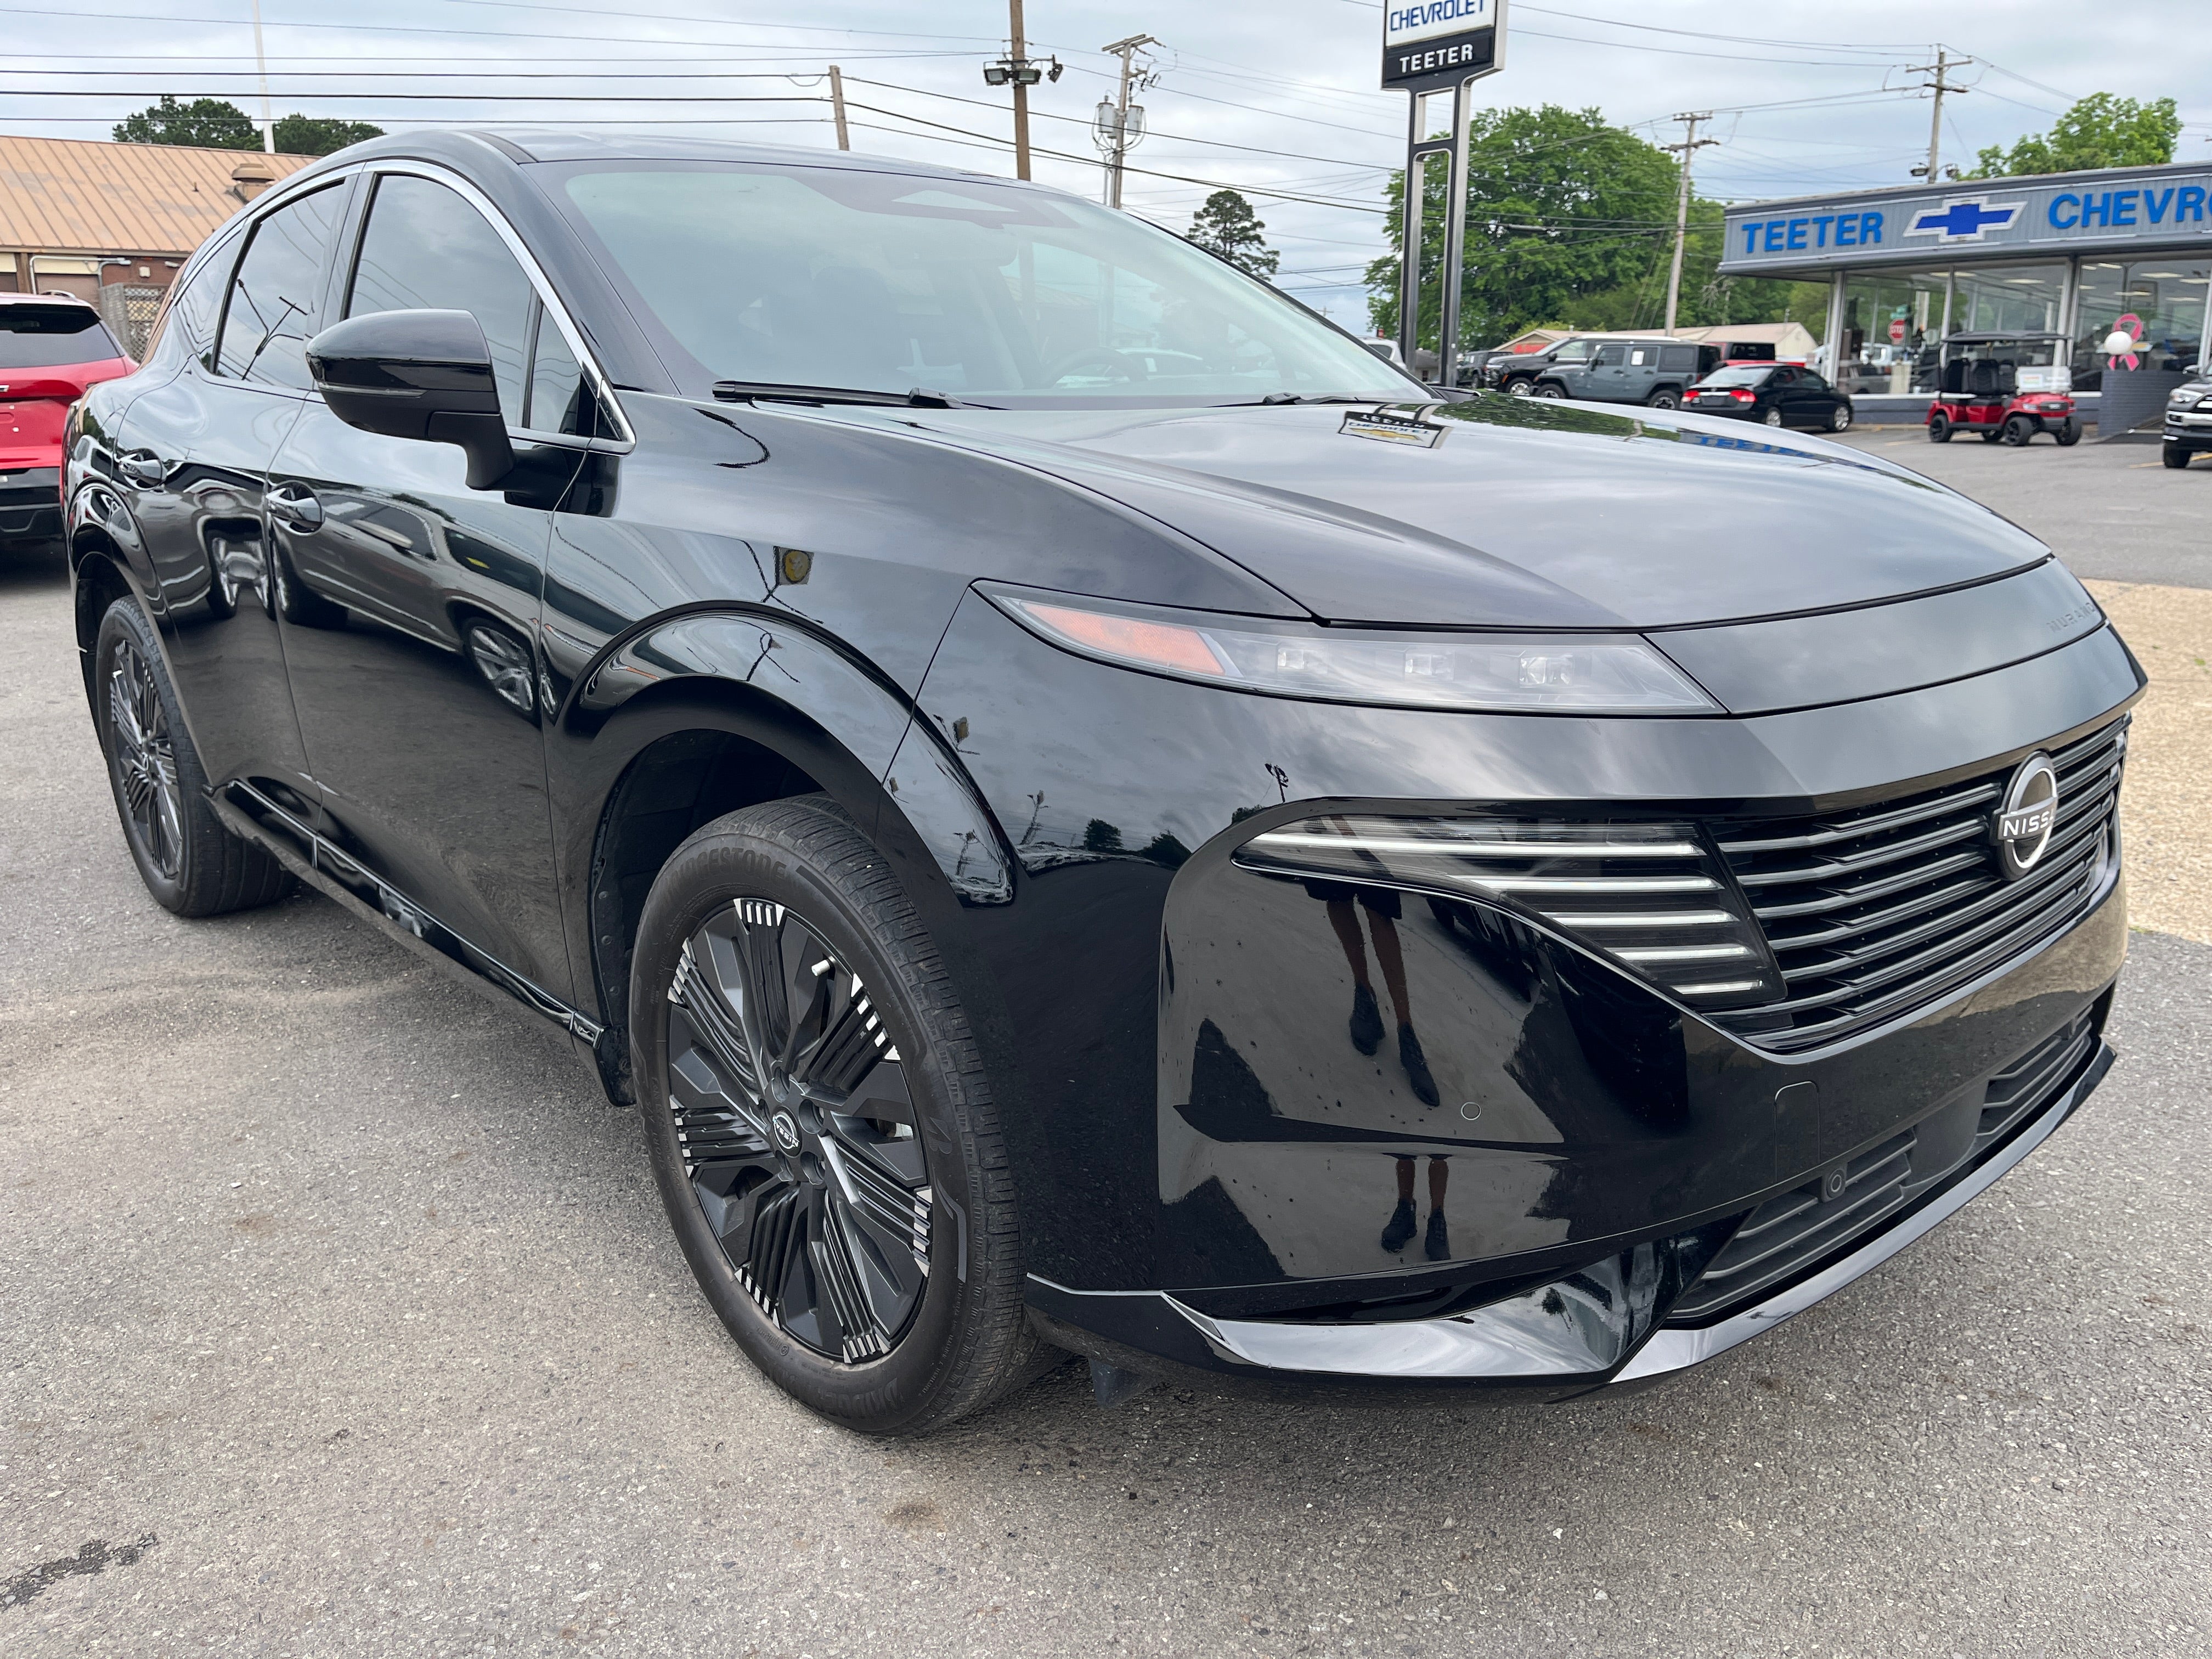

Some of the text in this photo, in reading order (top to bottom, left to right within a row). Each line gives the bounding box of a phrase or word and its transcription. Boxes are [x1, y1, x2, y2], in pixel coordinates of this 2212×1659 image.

[1399, 43, 1474, 73] TEETER
[1741, 185, 2212, 253] TEETER CHEVR
